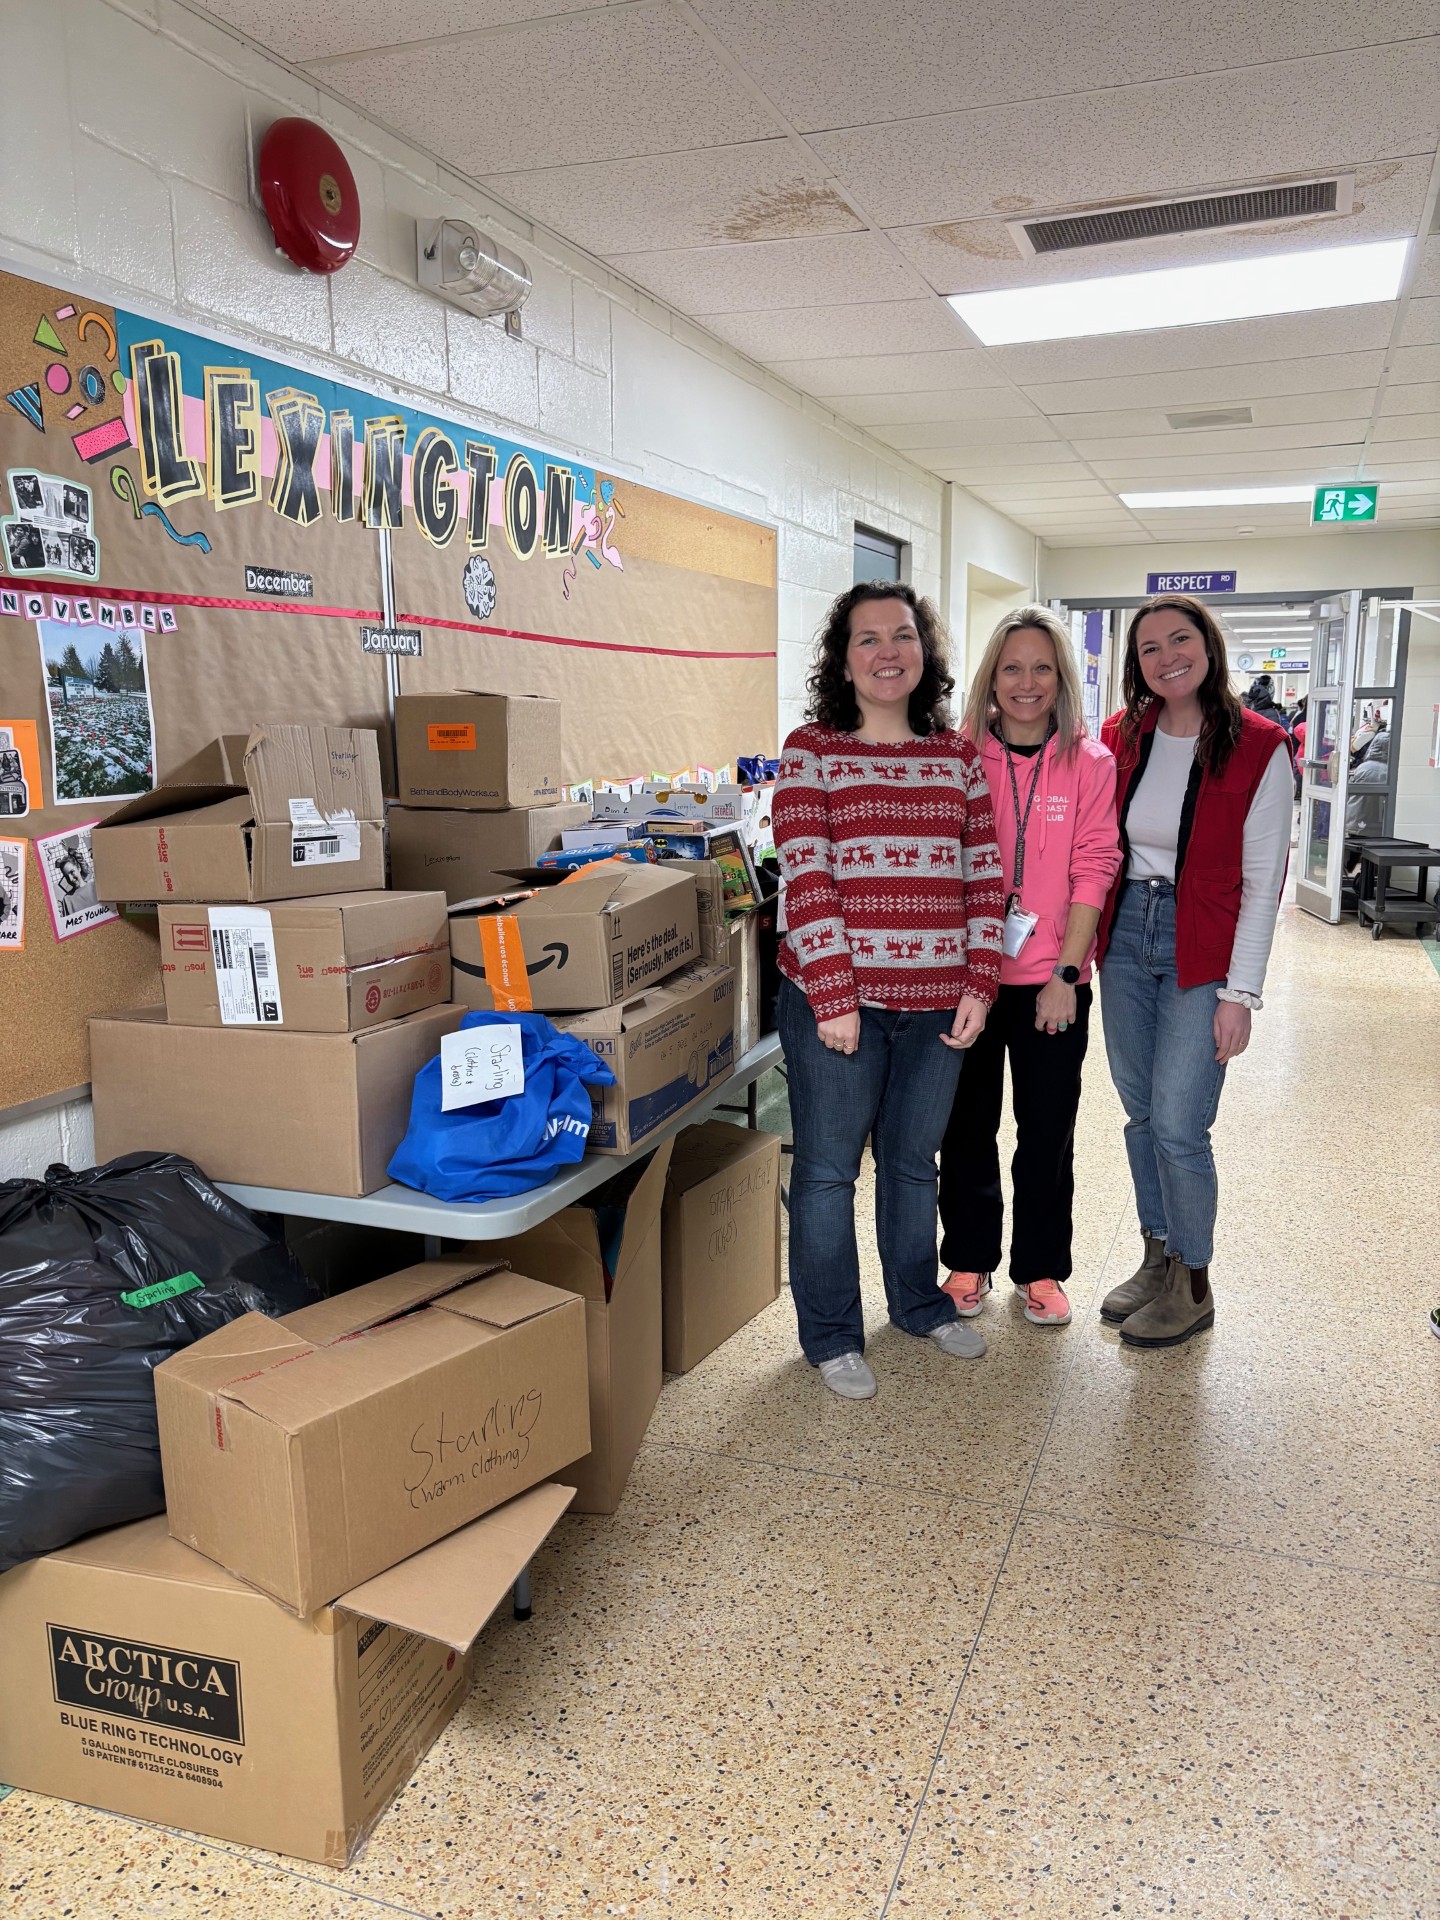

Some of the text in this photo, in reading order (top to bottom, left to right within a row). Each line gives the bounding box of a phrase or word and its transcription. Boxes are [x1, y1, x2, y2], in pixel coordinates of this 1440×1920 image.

[130, 338, 577, 562] LEXINGTON
[246, 569, 312, 594] December
[1158, 574, 1231, 590] RESPECT RD
[2, 593, 175, 627] NOVEMBER
[363, 628, 419, 655] January
[331, 751, 358, 763] Starling
[1033, 795, 1069, 803] GOBAL
[294, 849, 304, 860] 17
[65, 905, 110, 929] MRS YOUNG
[0, 932, 17, 940] ARR
[627, 922, 678, 963] Here's the deal.
[627, 952, 664, 985] (Seriously,
[664, 942, 680, 962] here
[266, 1004, 277, 1018] 17
[595, 1041, 613, 1053] 01
[484, 1043, 511, 1090] Starling
[136, 1285, 177, 1302] Starling
[404, 1388, 542, 1490] Starling
[409, 1436, 530, 1508] (warm clothing)
[58, 1636, 229, 1697] ARCTICA
[85, 1668, 215, 1721] Group U.S.A.
[60, 1712, 243, 1766] BLUE RING TECHNOLOGY
[82, 1748, 223, 1789] US PATENT# 6123122 & 6408904
[88, 1739, 127, 1755] GALLON
[128, 1748, 165, 1764] BOTTLE
[166, 1757, 219, 1777] CLOSURES
